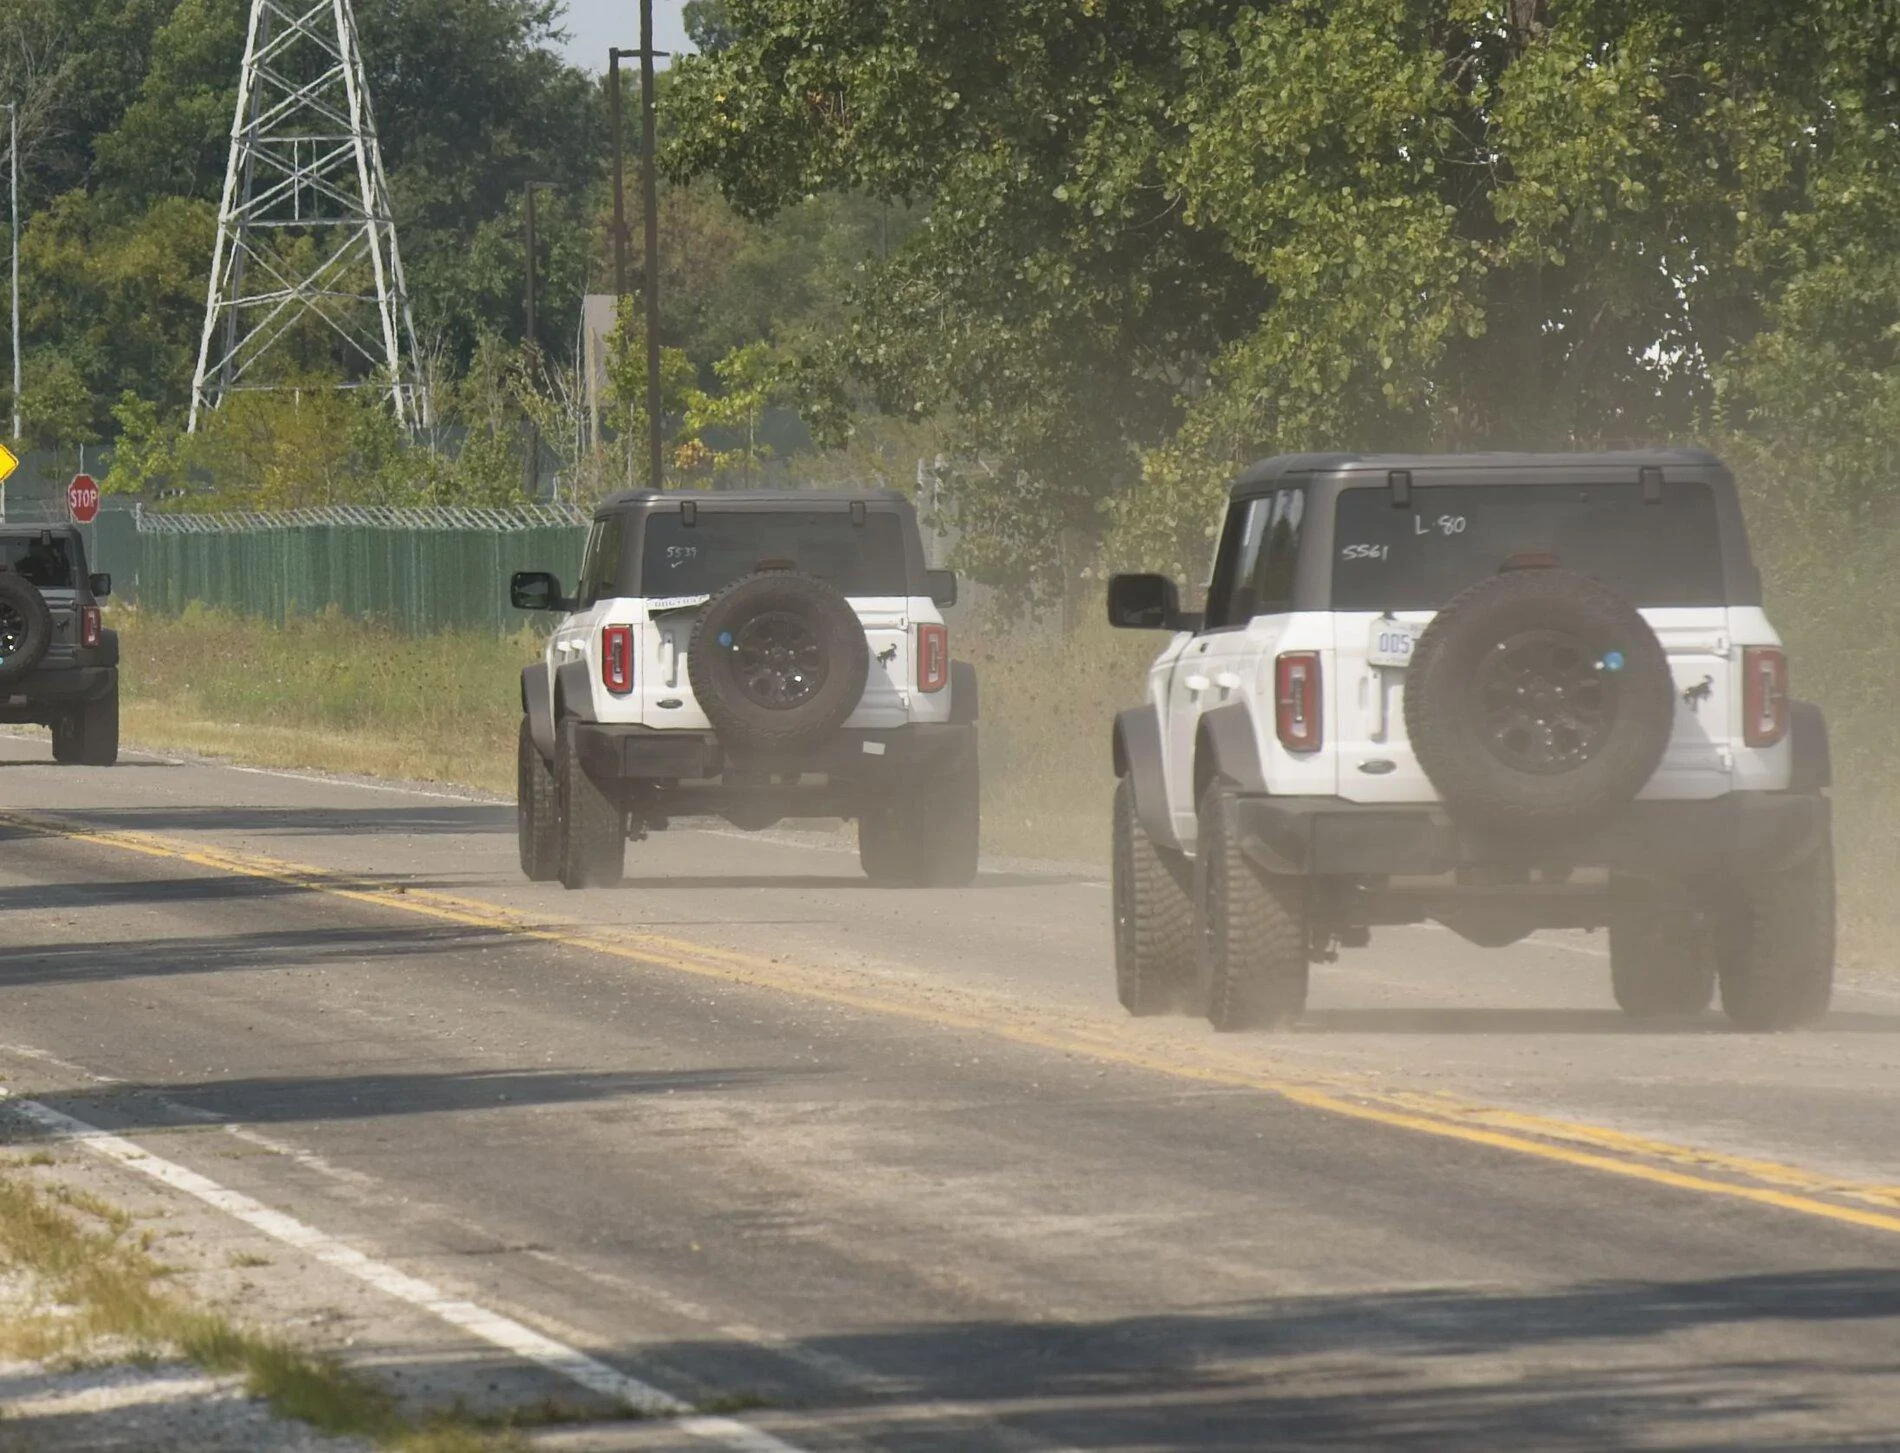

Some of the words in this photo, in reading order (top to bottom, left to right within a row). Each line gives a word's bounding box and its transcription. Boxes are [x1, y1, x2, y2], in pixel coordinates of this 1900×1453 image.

[70, 489, 97, 508] STOP
[666, 546, 697, 559] 5539
[1379, 632, 1418, 655] 005
